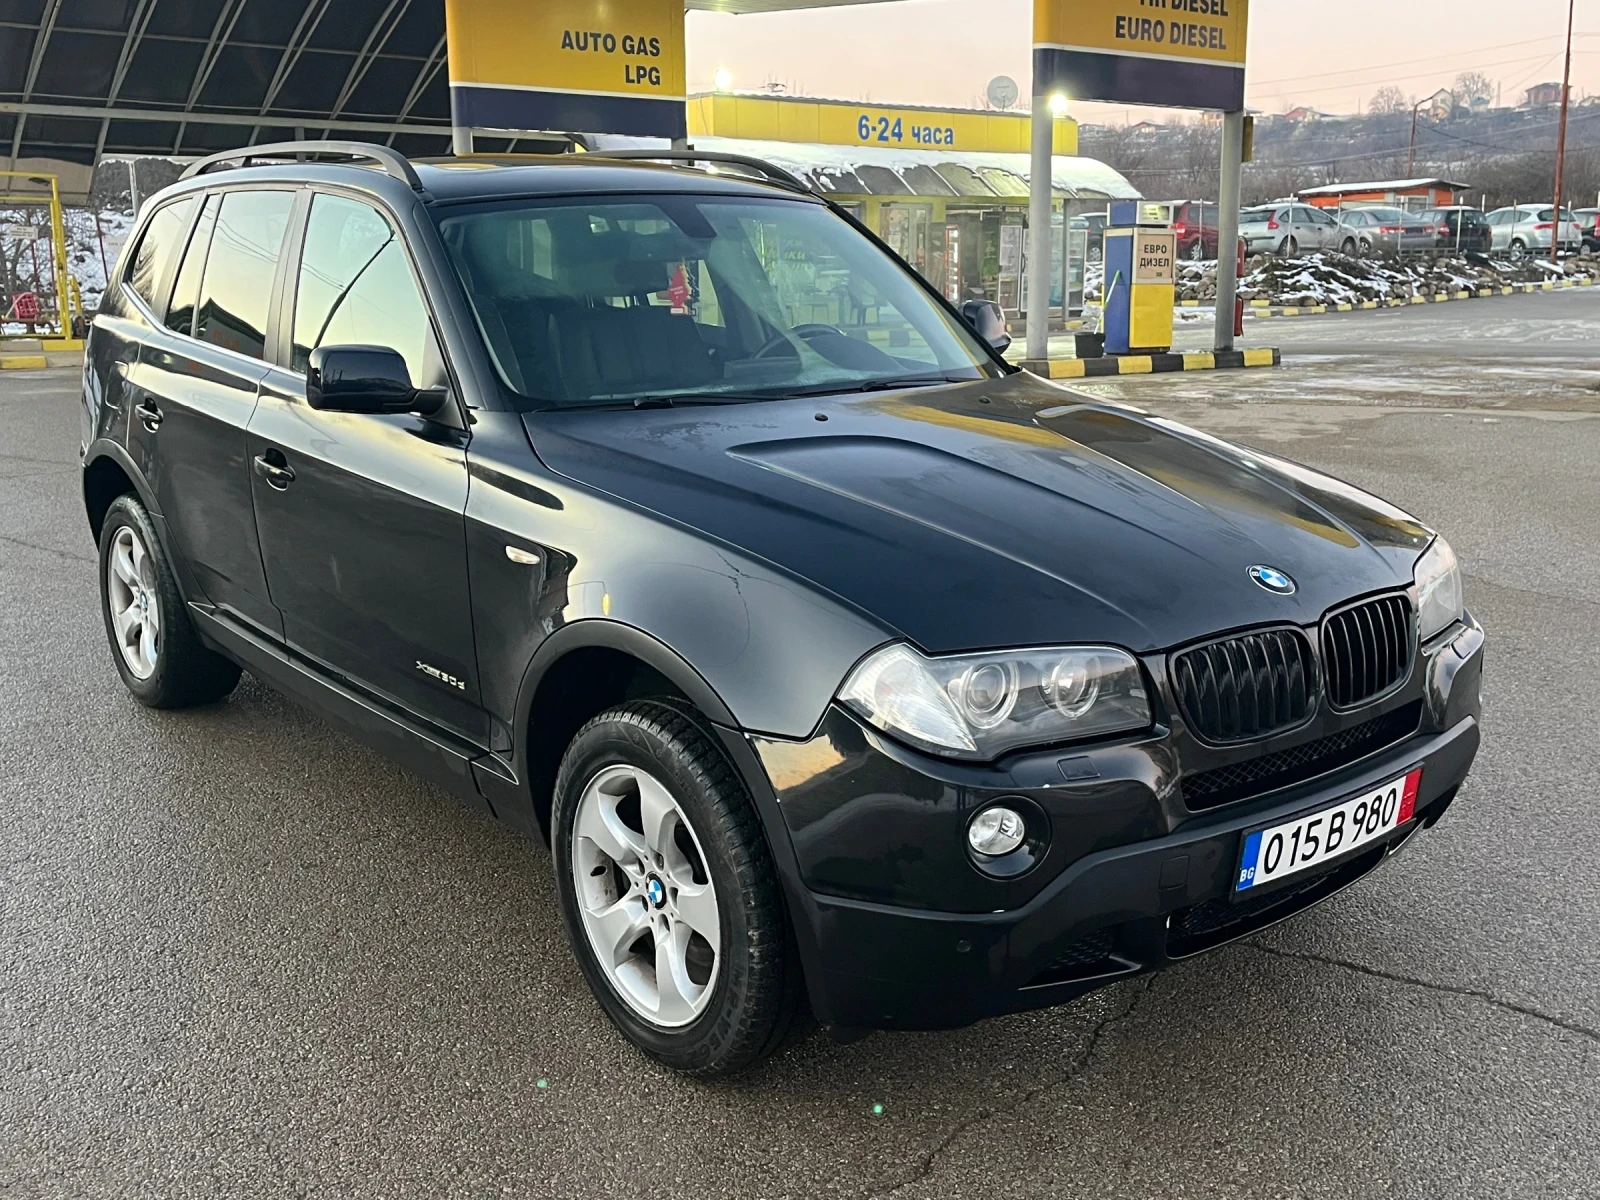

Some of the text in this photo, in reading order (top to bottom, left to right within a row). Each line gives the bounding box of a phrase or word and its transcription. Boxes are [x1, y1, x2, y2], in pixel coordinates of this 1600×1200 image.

[561, 30, 661, 57] AUTO GAS
[1115, 15, 1227, 50] EURO DIESEL
[625, 64, 661, 86] LPG
[858, 115, 954, 145] 6-24 часа
[1143, 244, 1168, 254] ЕВРО
[1139, 257, 1170, 269] ДИЗЕЛ
[1263, 818, 1323, 874] 015
[1351, 788, 1397, 843] 980
[1240, 867, 1255, 883] BG
